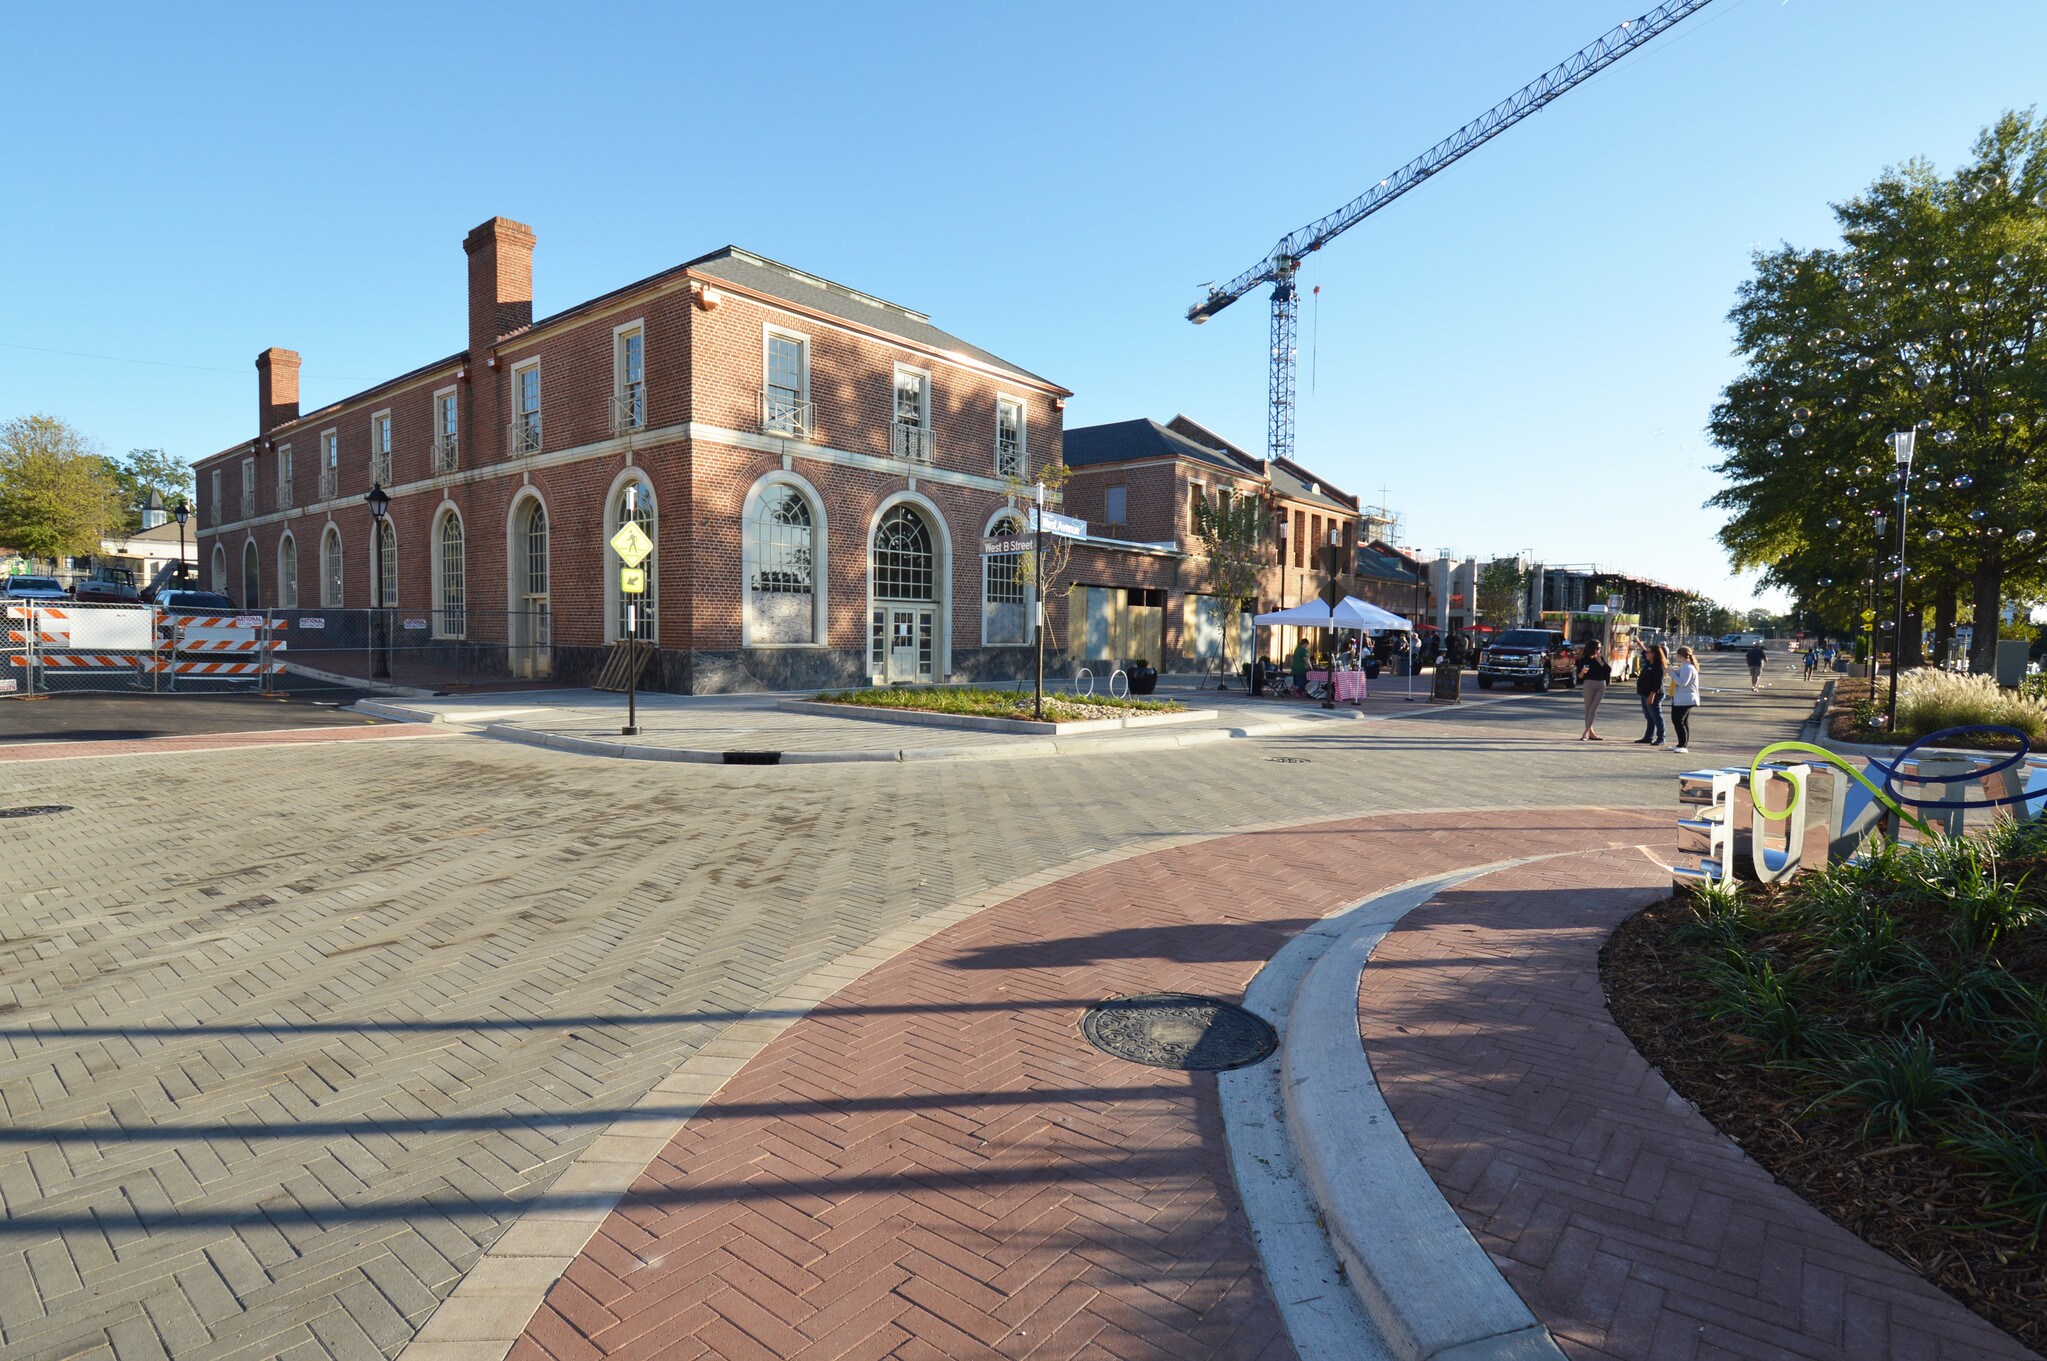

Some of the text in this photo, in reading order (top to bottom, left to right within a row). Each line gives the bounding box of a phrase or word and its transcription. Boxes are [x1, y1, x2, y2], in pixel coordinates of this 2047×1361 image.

[1042, 518, 1079, 535] West Avenue
[985, 540, 1033, 553] West B Street
